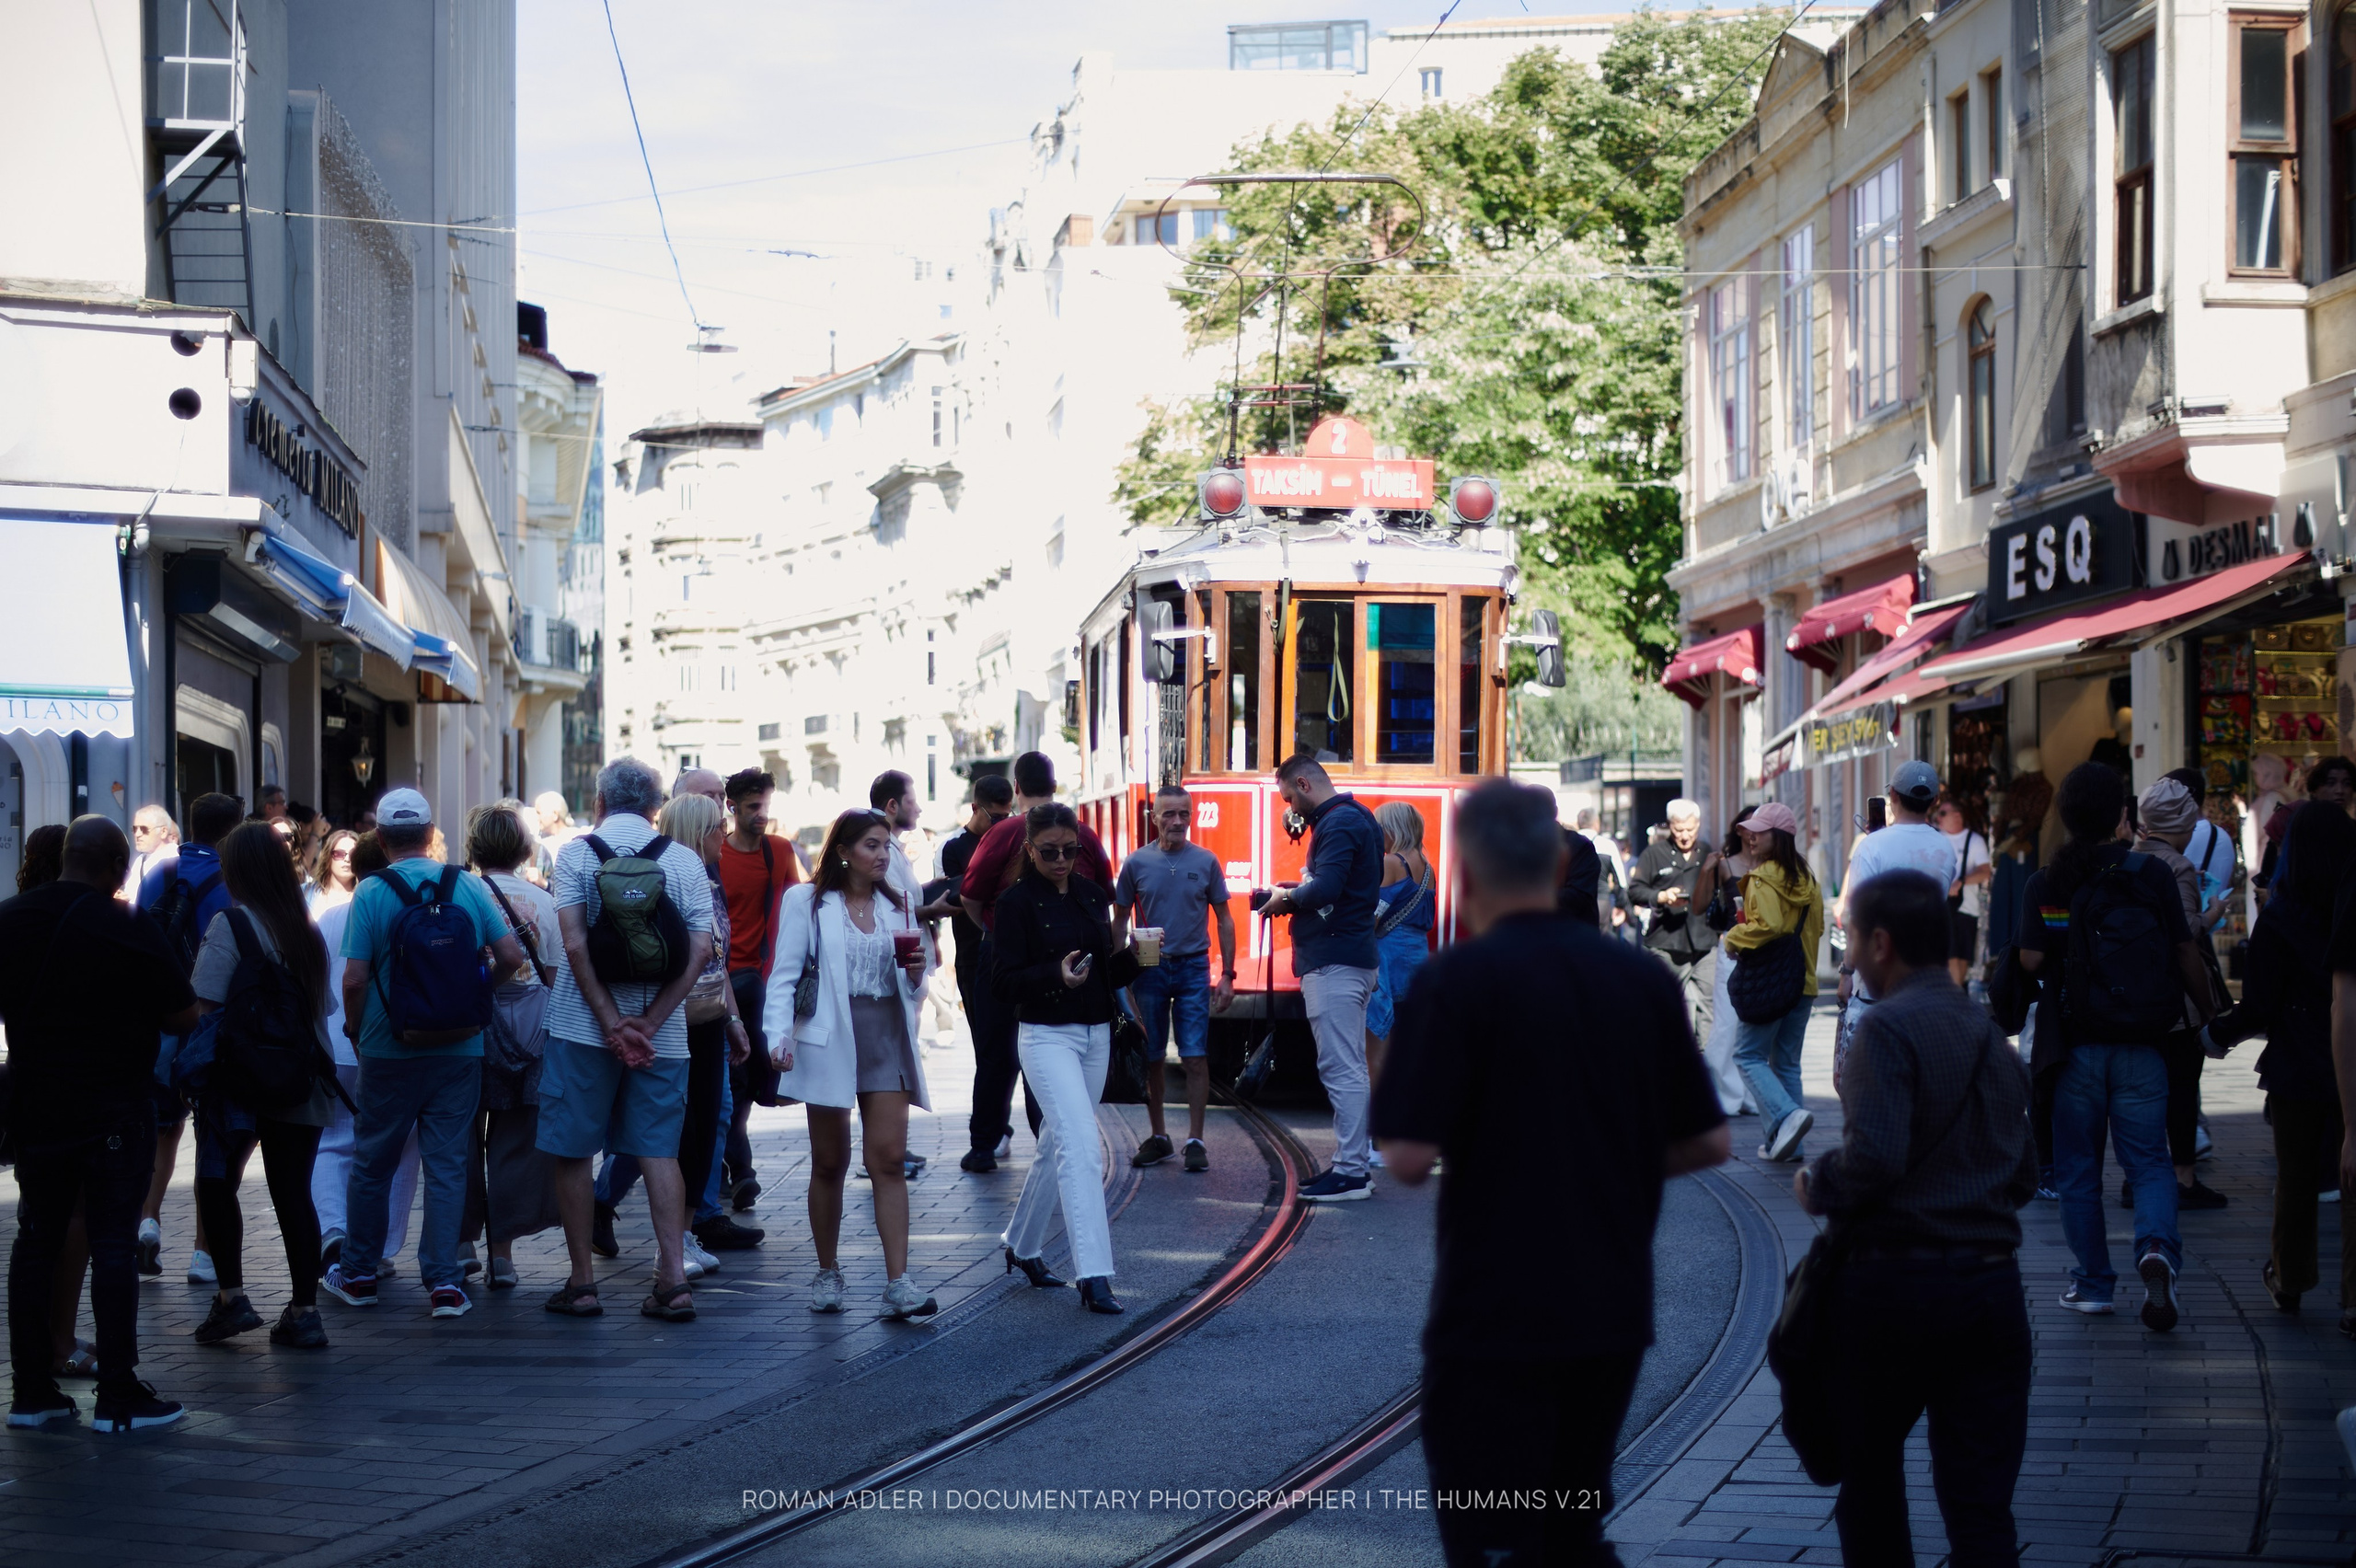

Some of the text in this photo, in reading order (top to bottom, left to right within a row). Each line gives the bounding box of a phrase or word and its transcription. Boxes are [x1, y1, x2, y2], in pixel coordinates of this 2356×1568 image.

[1331, 422, 1347, 455] 2
[317, 449, 361, 539] MILANO
[1251, 463, 1322, 496] TAKSİM
[1360, 465, 1423, 499] TÜNEL
[2007, 515, 2091, 601] ESQ
[2189, 512, 2285, 574] DESMAL
